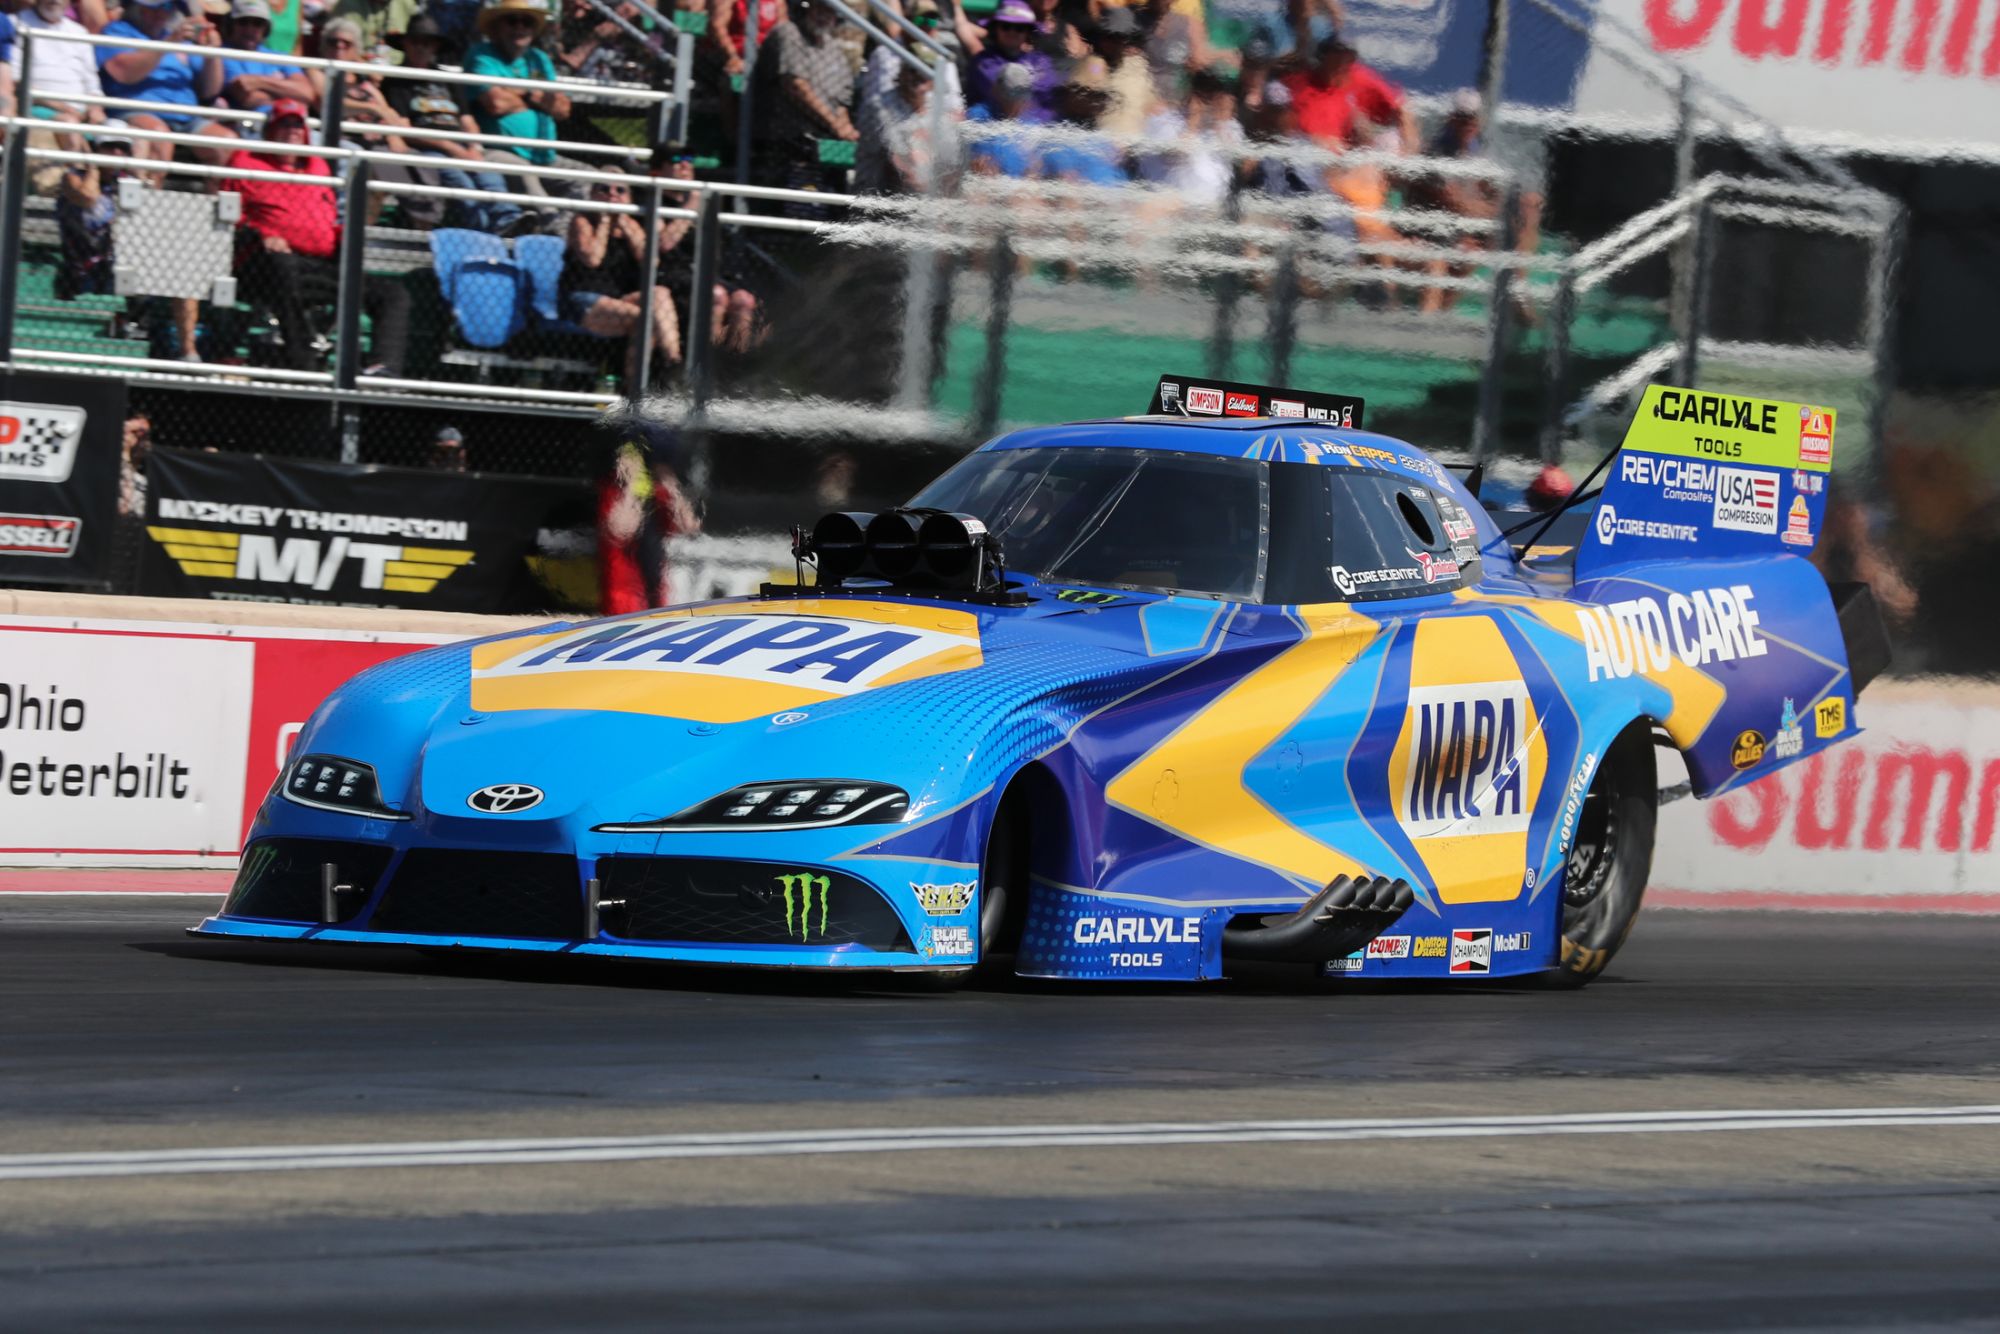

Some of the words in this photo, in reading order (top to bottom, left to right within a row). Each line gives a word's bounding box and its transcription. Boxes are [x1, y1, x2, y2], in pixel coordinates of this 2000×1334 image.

[1190, 391, 1220, 411] SIMPSON
[1227, 396, 1256, 413] Edelbrock
[1660, 391, 1778, 434] CARLYLE
[1349, 445, 1397, 465] CAPPS
[1694, 437, 1742, 457] TOOLS
[1621, 455, 1716, 491] REVCHEM
[1663, 487, 1713, 503] Composites
[1720, 474, 1755, 507] USA
[159, 498, 283, 527] MICKEY
[286, 508, 468, 541] THOMPSON
[1718, 508, 1774, 526] COMPRESSION
[1616, 518, 1646, 535] CORE
[1646, 521, 1698, 542] SCIENTIFIC
[235, 533, 403, 591] M/T
[1351, 570, 1379, 584] CORE
[1378, 568, 1422, 582] SCIENTIFIC
[1574, 596, 1671, 683] AUTO
[1667, 584, 1768, 668] CARE
[519, 618, 923, 684] NAPA
[1819, 703, 1841, 726] TMS
[1410, 698, 1521, 821] NAPA
[0, 751, 191, 799] eterbilt
[933, 928, 968, 942] BLUE
[1073, 917, 1201, 944] CARLYLE
[934, 941, 973, 955] WOLF
[1369, 939, 1401, 954] COMP
[1454, 944, 1488, 958] CHAMPION
[1494, 933, 1521, 952] Mobil
[1110, 953, 1163, 967] TOOLS
